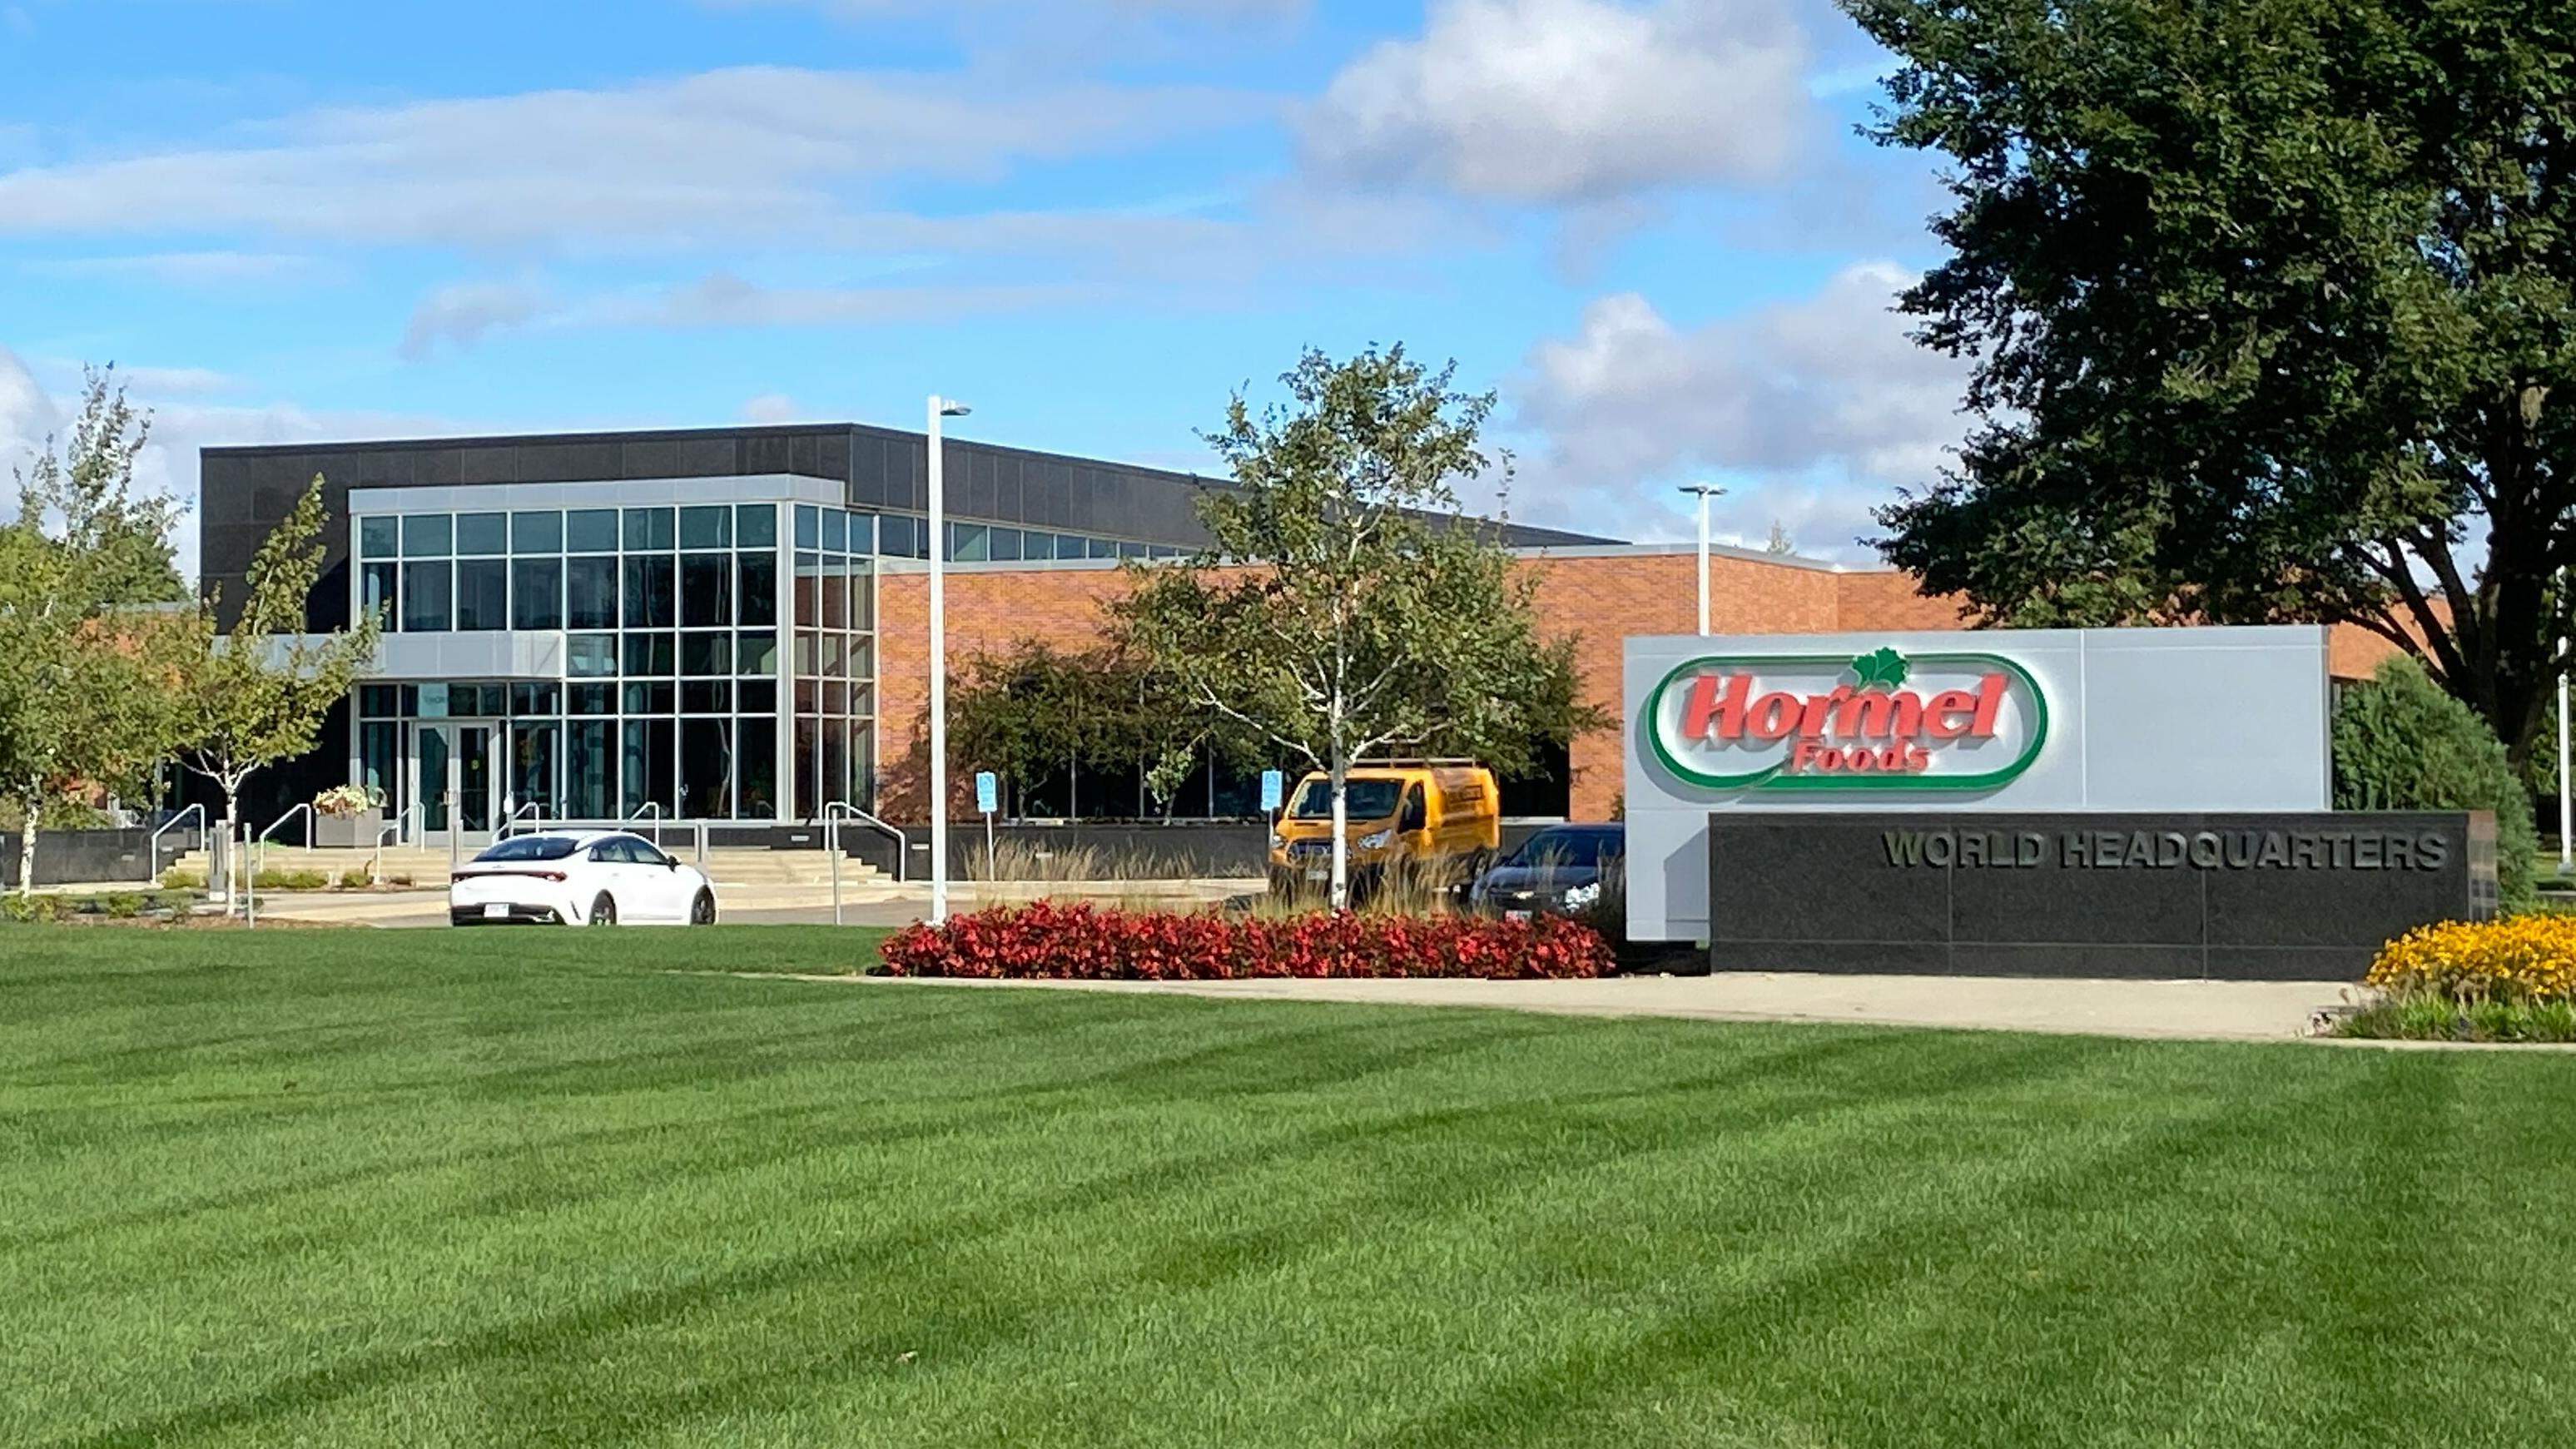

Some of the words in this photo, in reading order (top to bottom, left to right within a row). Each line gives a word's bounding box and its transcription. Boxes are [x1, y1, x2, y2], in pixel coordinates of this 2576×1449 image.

[1683, 671, 2009, 739] Hormel
[1790, 740, 1930, 773] Foods
[1881, 832, 2045, 867] WORLD
[2060, 832, 2449, 870] HEADQUARTERS
